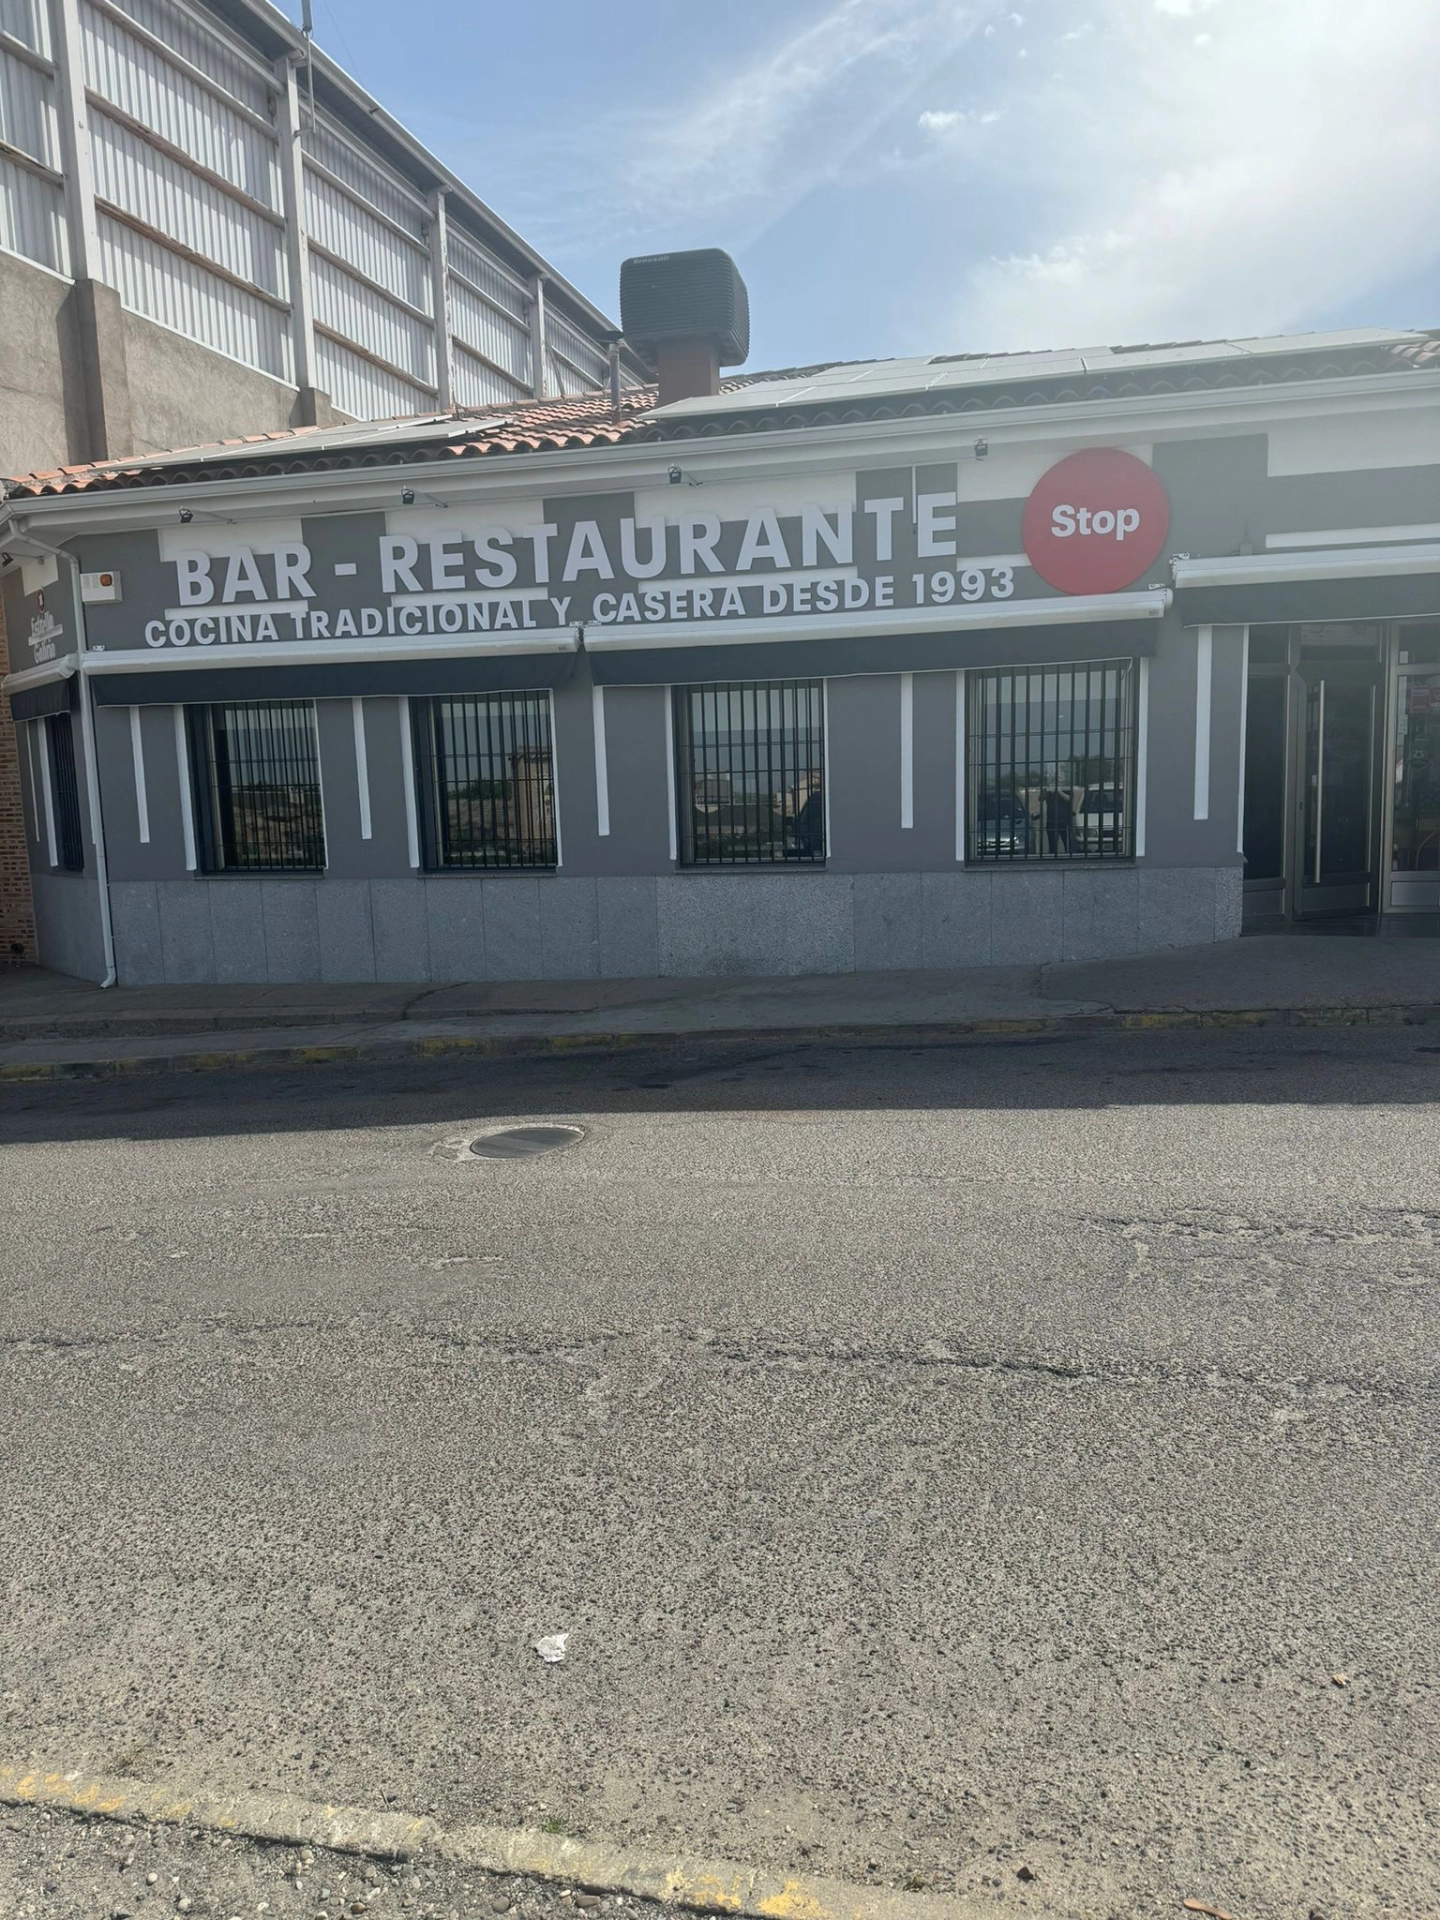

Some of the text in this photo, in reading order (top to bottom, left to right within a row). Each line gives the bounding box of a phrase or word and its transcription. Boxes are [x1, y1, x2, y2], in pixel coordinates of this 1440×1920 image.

[175, 543, 316, 605] BAR
[379, 491, 956, 592] RESTAURANTE
[1051, 504, 1140, 540] Stop
[145, 566, 1014, 647] COCINA TRADICIONAL Y CASERA DESDE 1993
